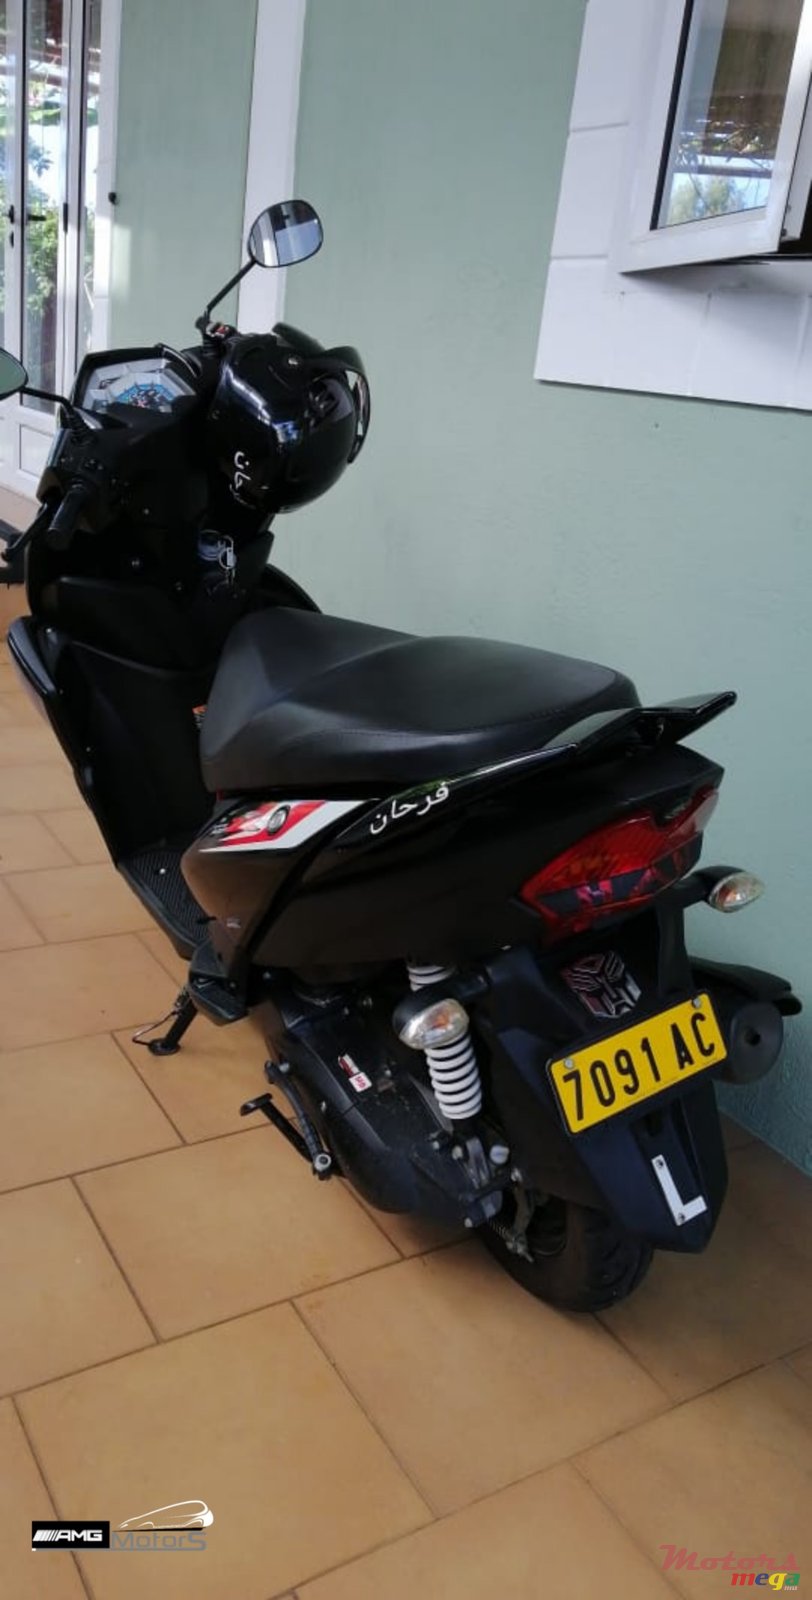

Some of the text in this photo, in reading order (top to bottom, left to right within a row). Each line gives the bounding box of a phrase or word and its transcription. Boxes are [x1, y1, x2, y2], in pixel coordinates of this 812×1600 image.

[369, 782, 449, 835] فرحان
[563, 1012, 715, 1121] 7091 AC
[651, 1154, 707, 1226] L
